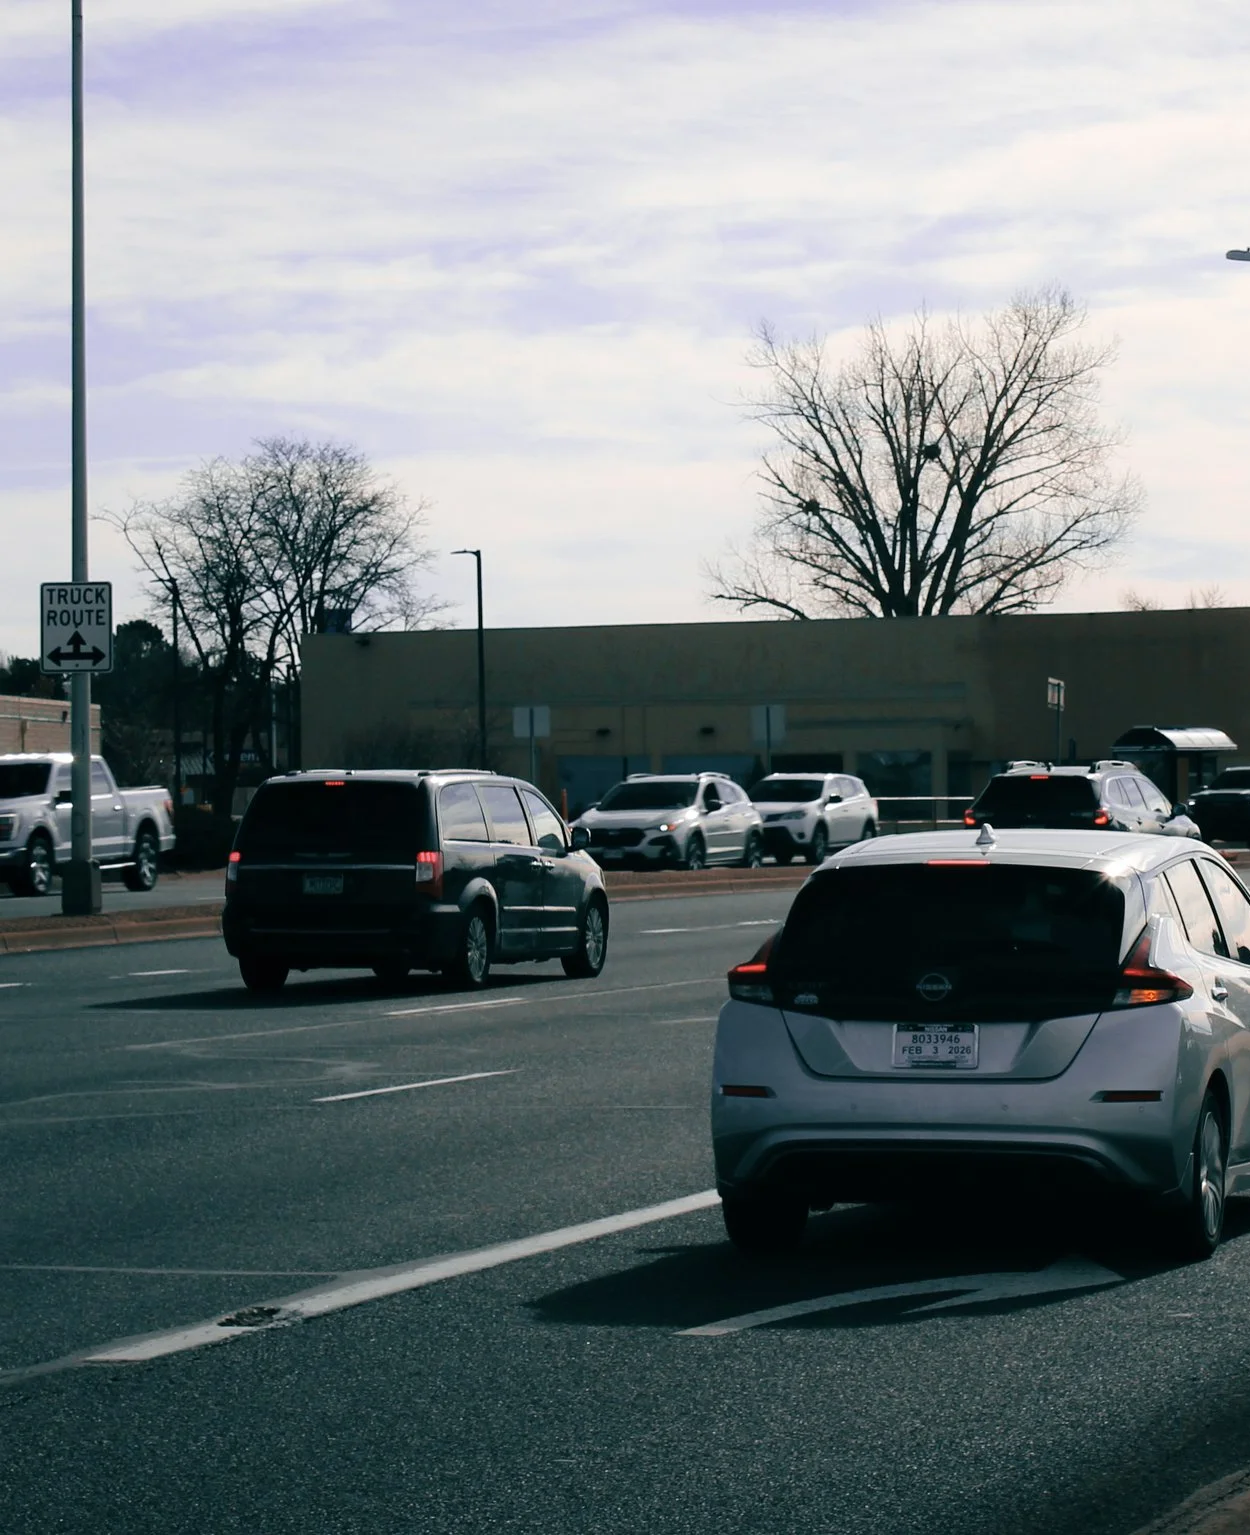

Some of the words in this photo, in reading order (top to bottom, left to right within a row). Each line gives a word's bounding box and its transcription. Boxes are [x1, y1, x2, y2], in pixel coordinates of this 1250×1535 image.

[46, 588, 106, 605] TRUCK
[47, 609, 106, 626] ROUTE
[911, 1034, 961, 1044] 8033946
[902, 1046, 922, 1055] FEB
[932, 1046, 939, 1055] 3
[948, 1046, 972, 1055] 2026
